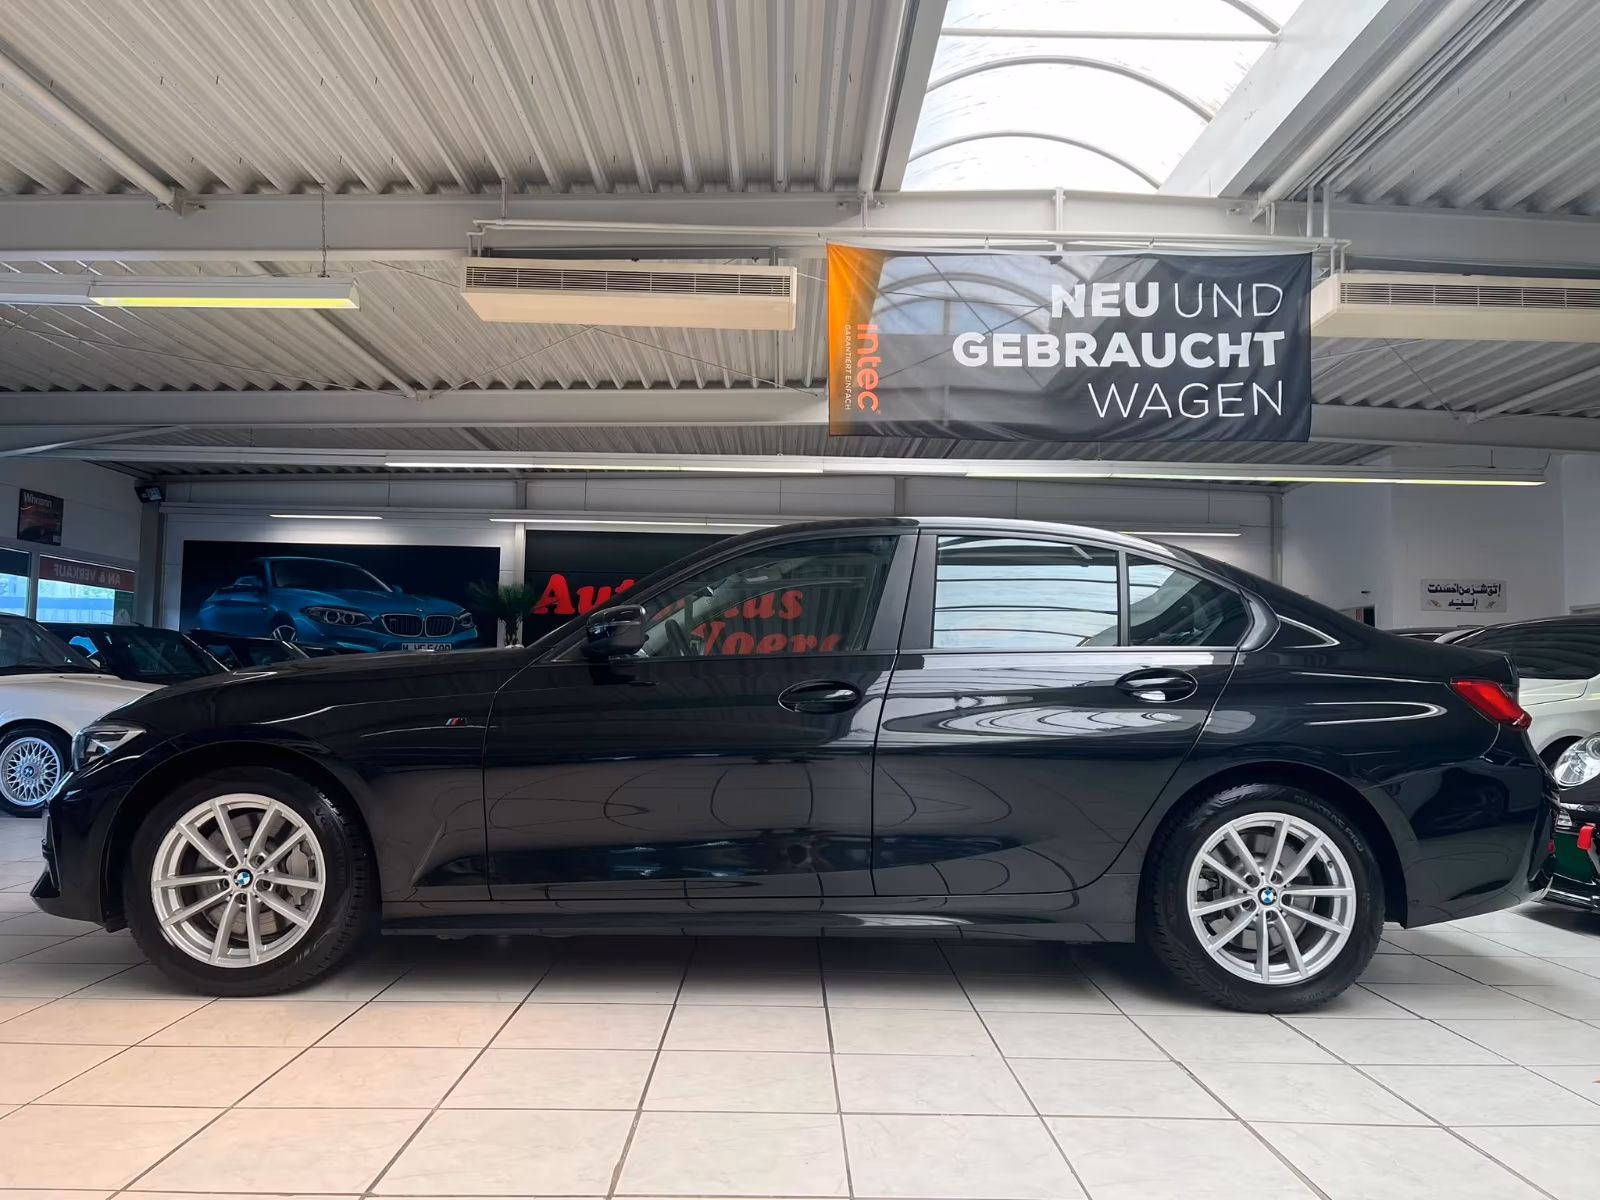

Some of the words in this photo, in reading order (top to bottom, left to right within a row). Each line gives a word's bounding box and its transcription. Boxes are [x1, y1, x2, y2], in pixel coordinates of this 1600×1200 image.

[1051, 281, 1160, 318] NEU
[1174, 282, 1283, 318] UND
[844, 324, 852, 374] GARANTIERT
[952, 330, 1285, 368] GEBRAUCHT
[844, 375, 852, 410] EINFACH
[1087, 380, 1283, 418] WAGEN
